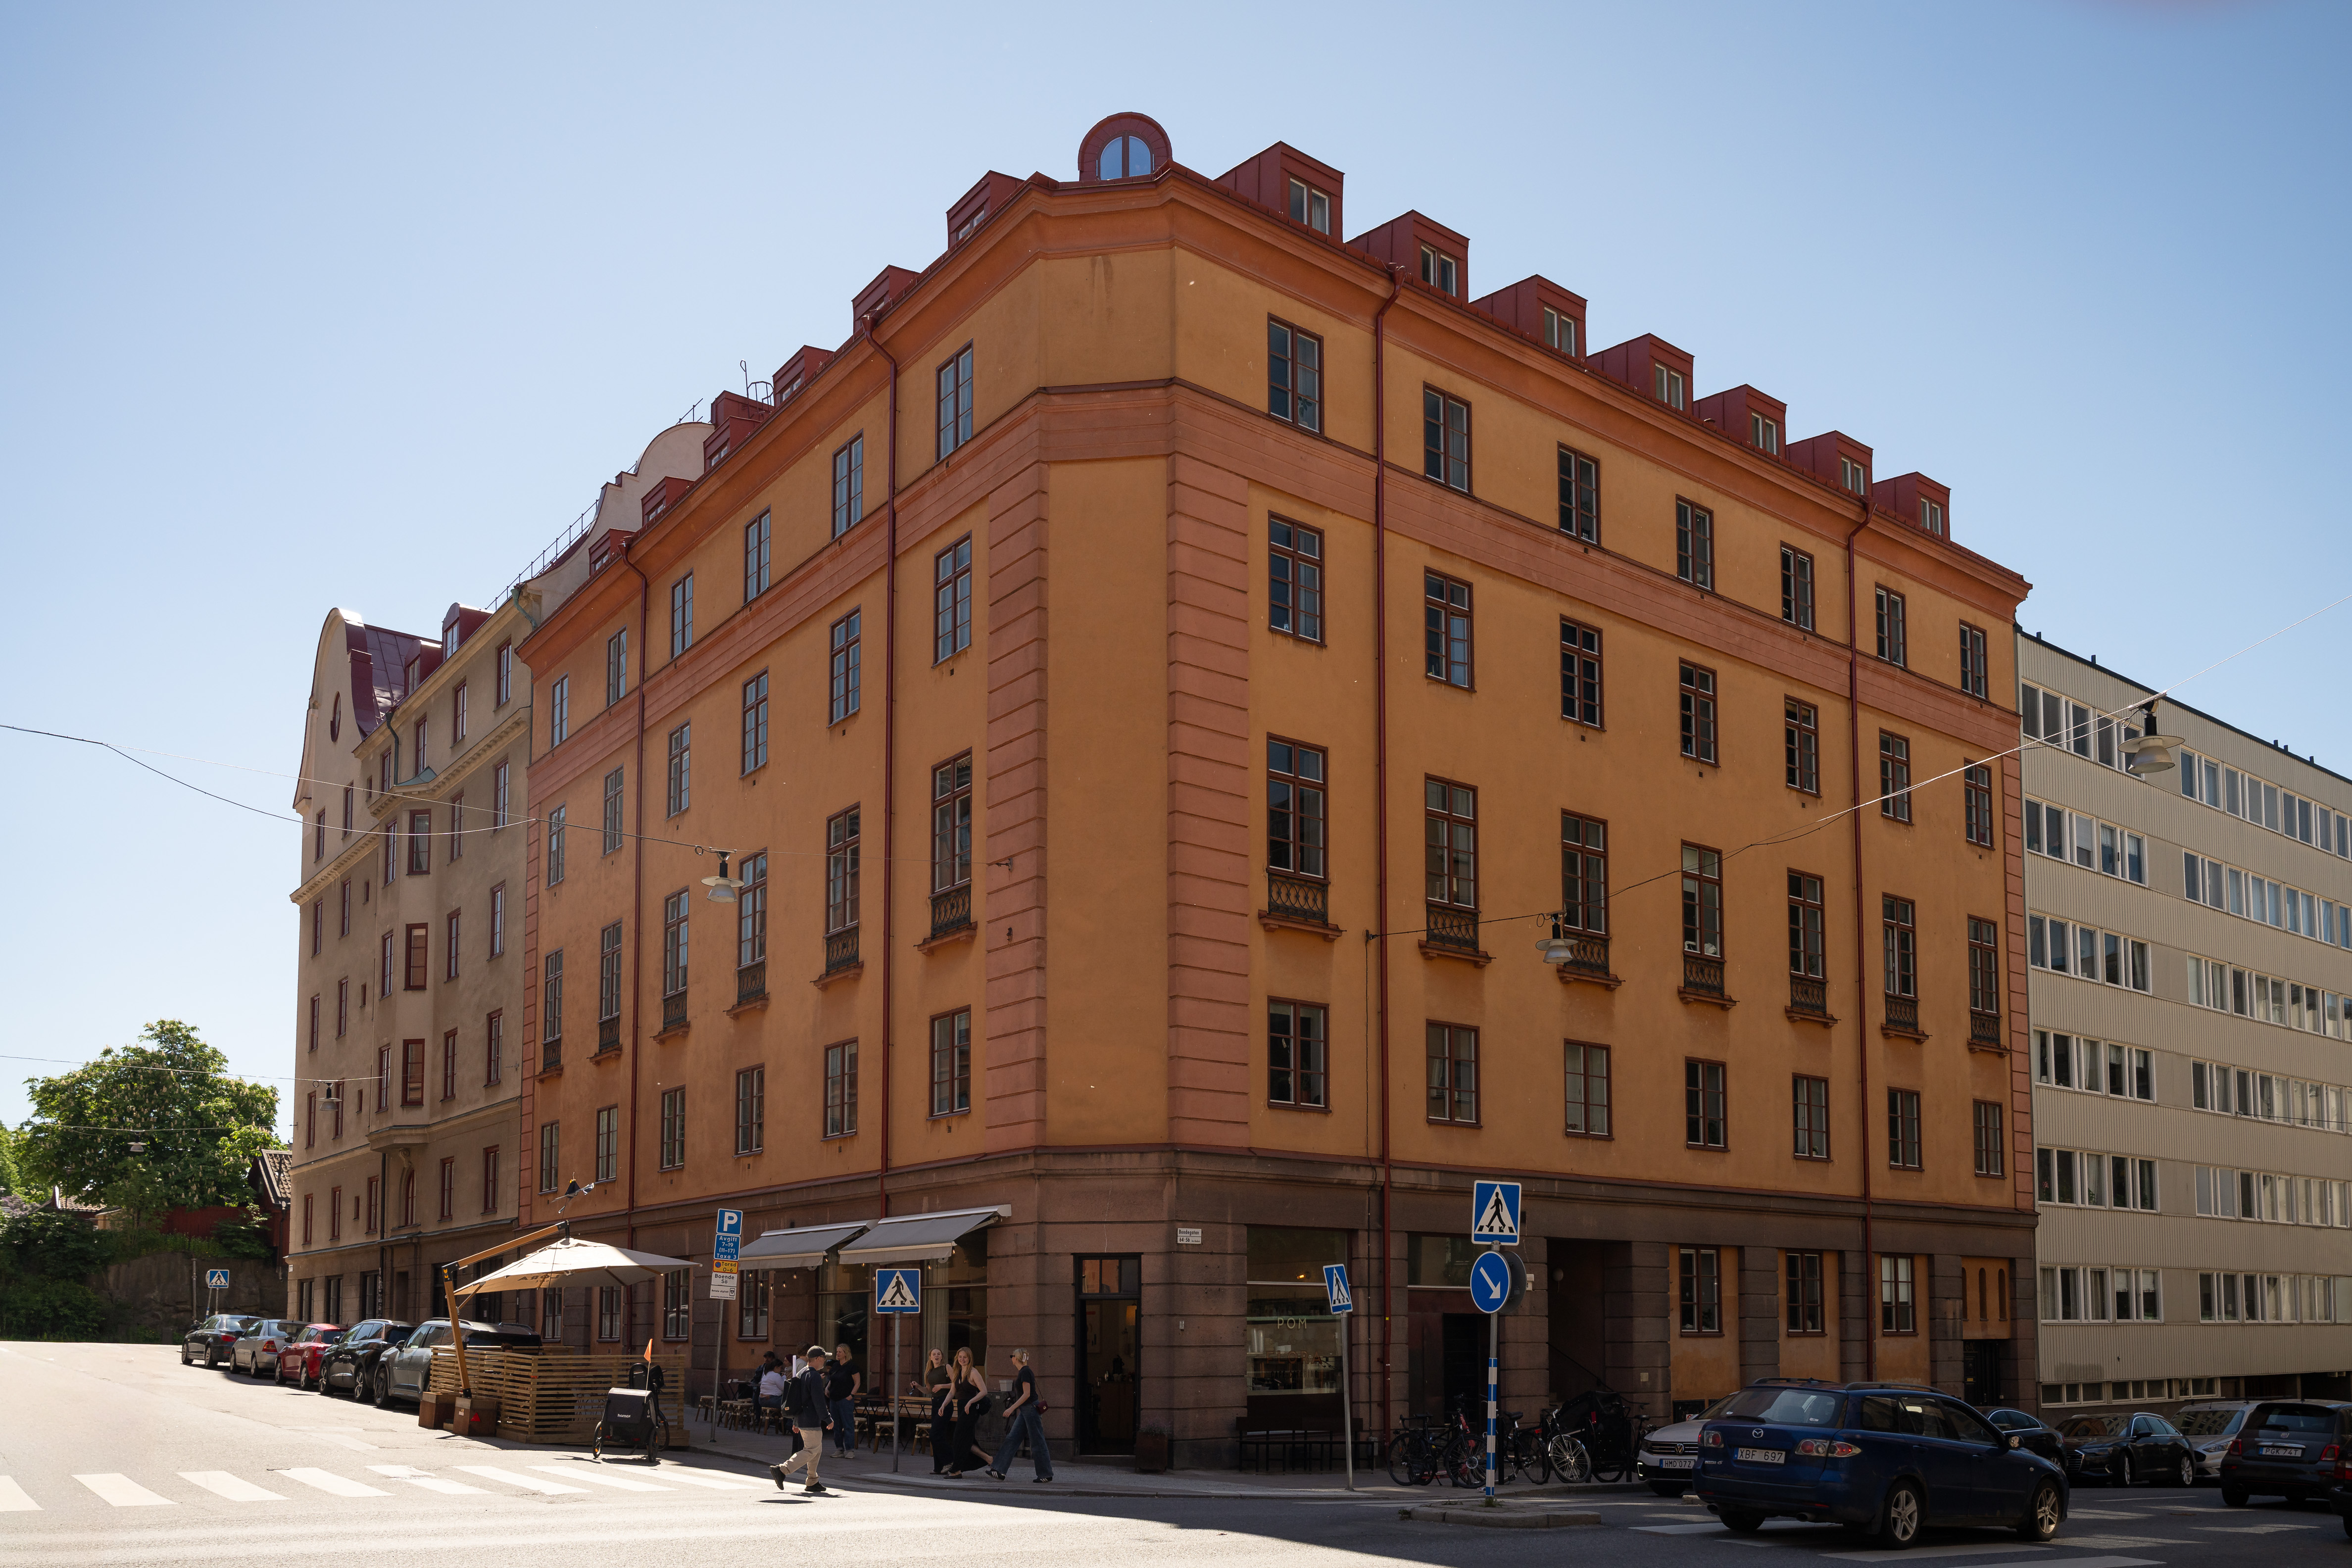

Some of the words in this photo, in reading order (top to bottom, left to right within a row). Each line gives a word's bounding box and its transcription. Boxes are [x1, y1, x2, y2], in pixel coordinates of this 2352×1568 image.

[723, 1212, 737, 1231] P
[1277, 1317, 1307, 1329] POM
[1267, 1350, 1323, 1364] FLORA
[1739, 1449, 1757, 1459] XBF
[1764, 1451, 1783, 1462] 697
